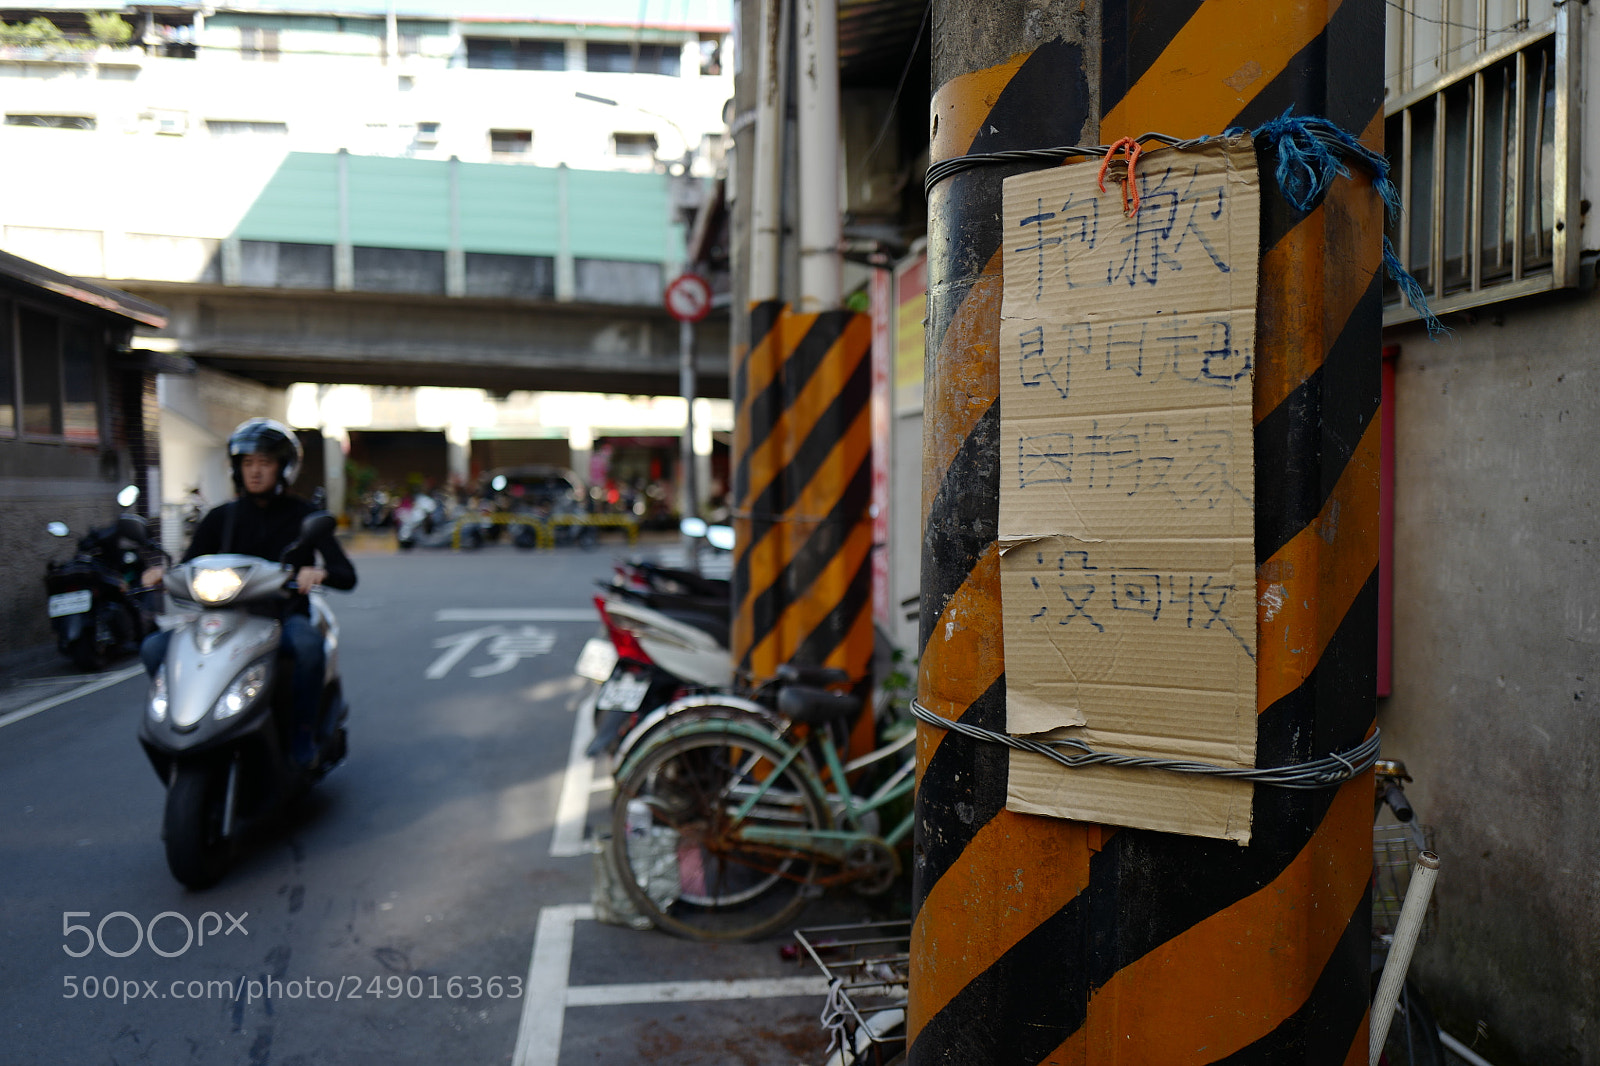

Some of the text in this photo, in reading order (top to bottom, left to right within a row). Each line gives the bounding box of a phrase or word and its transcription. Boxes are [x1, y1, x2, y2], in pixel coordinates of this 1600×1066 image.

[1015, 164, 1231, 301] 抱歉
[1019, 310, 1252, 398] 即日起
